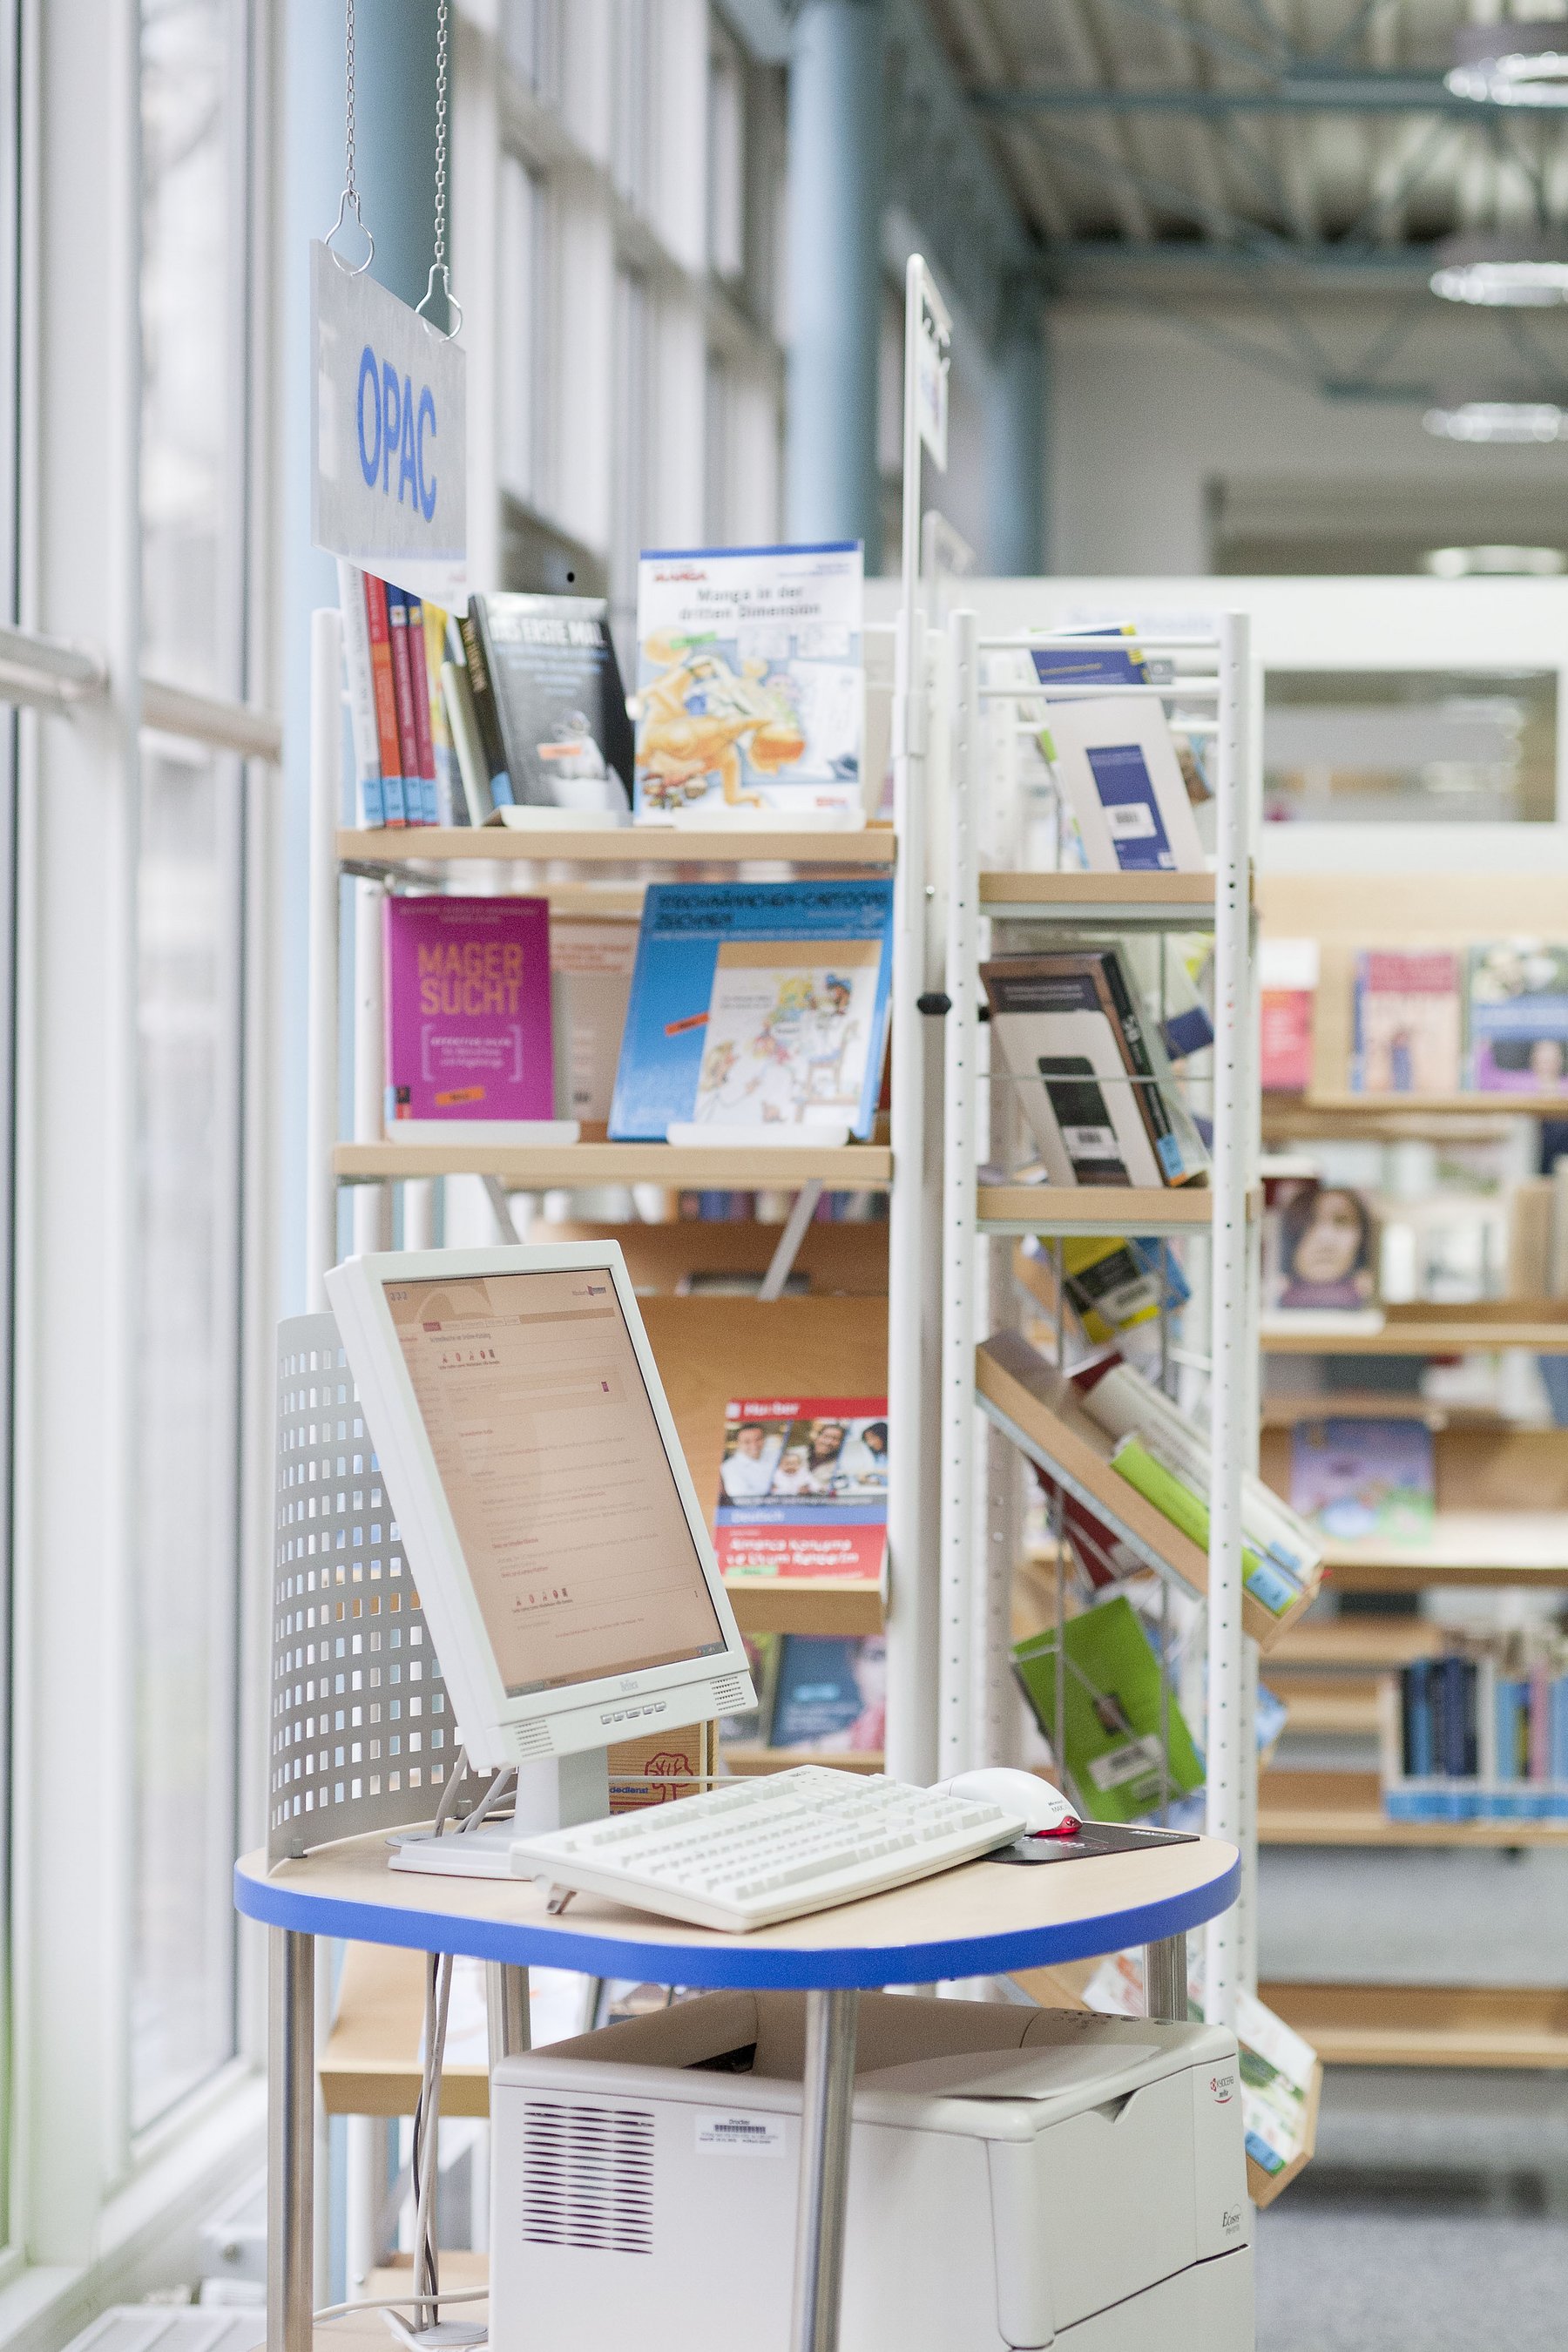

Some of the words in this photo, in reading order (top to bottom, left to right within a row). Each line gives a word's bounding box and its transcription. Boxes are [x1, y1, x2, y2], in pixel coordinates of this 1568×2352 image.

[357, 344, 436, 523] OPAC
[679, 605, 731, 620] dritten
[738, 603, 821, 618] Dimension
[699, 588, 750, 603] Manga
[756, 589, 772, 599] in
[778, 586, 803, 598] der
[418, 942, 523, 980] MAGER
[420, 977, 522, 1016] SUCHT
